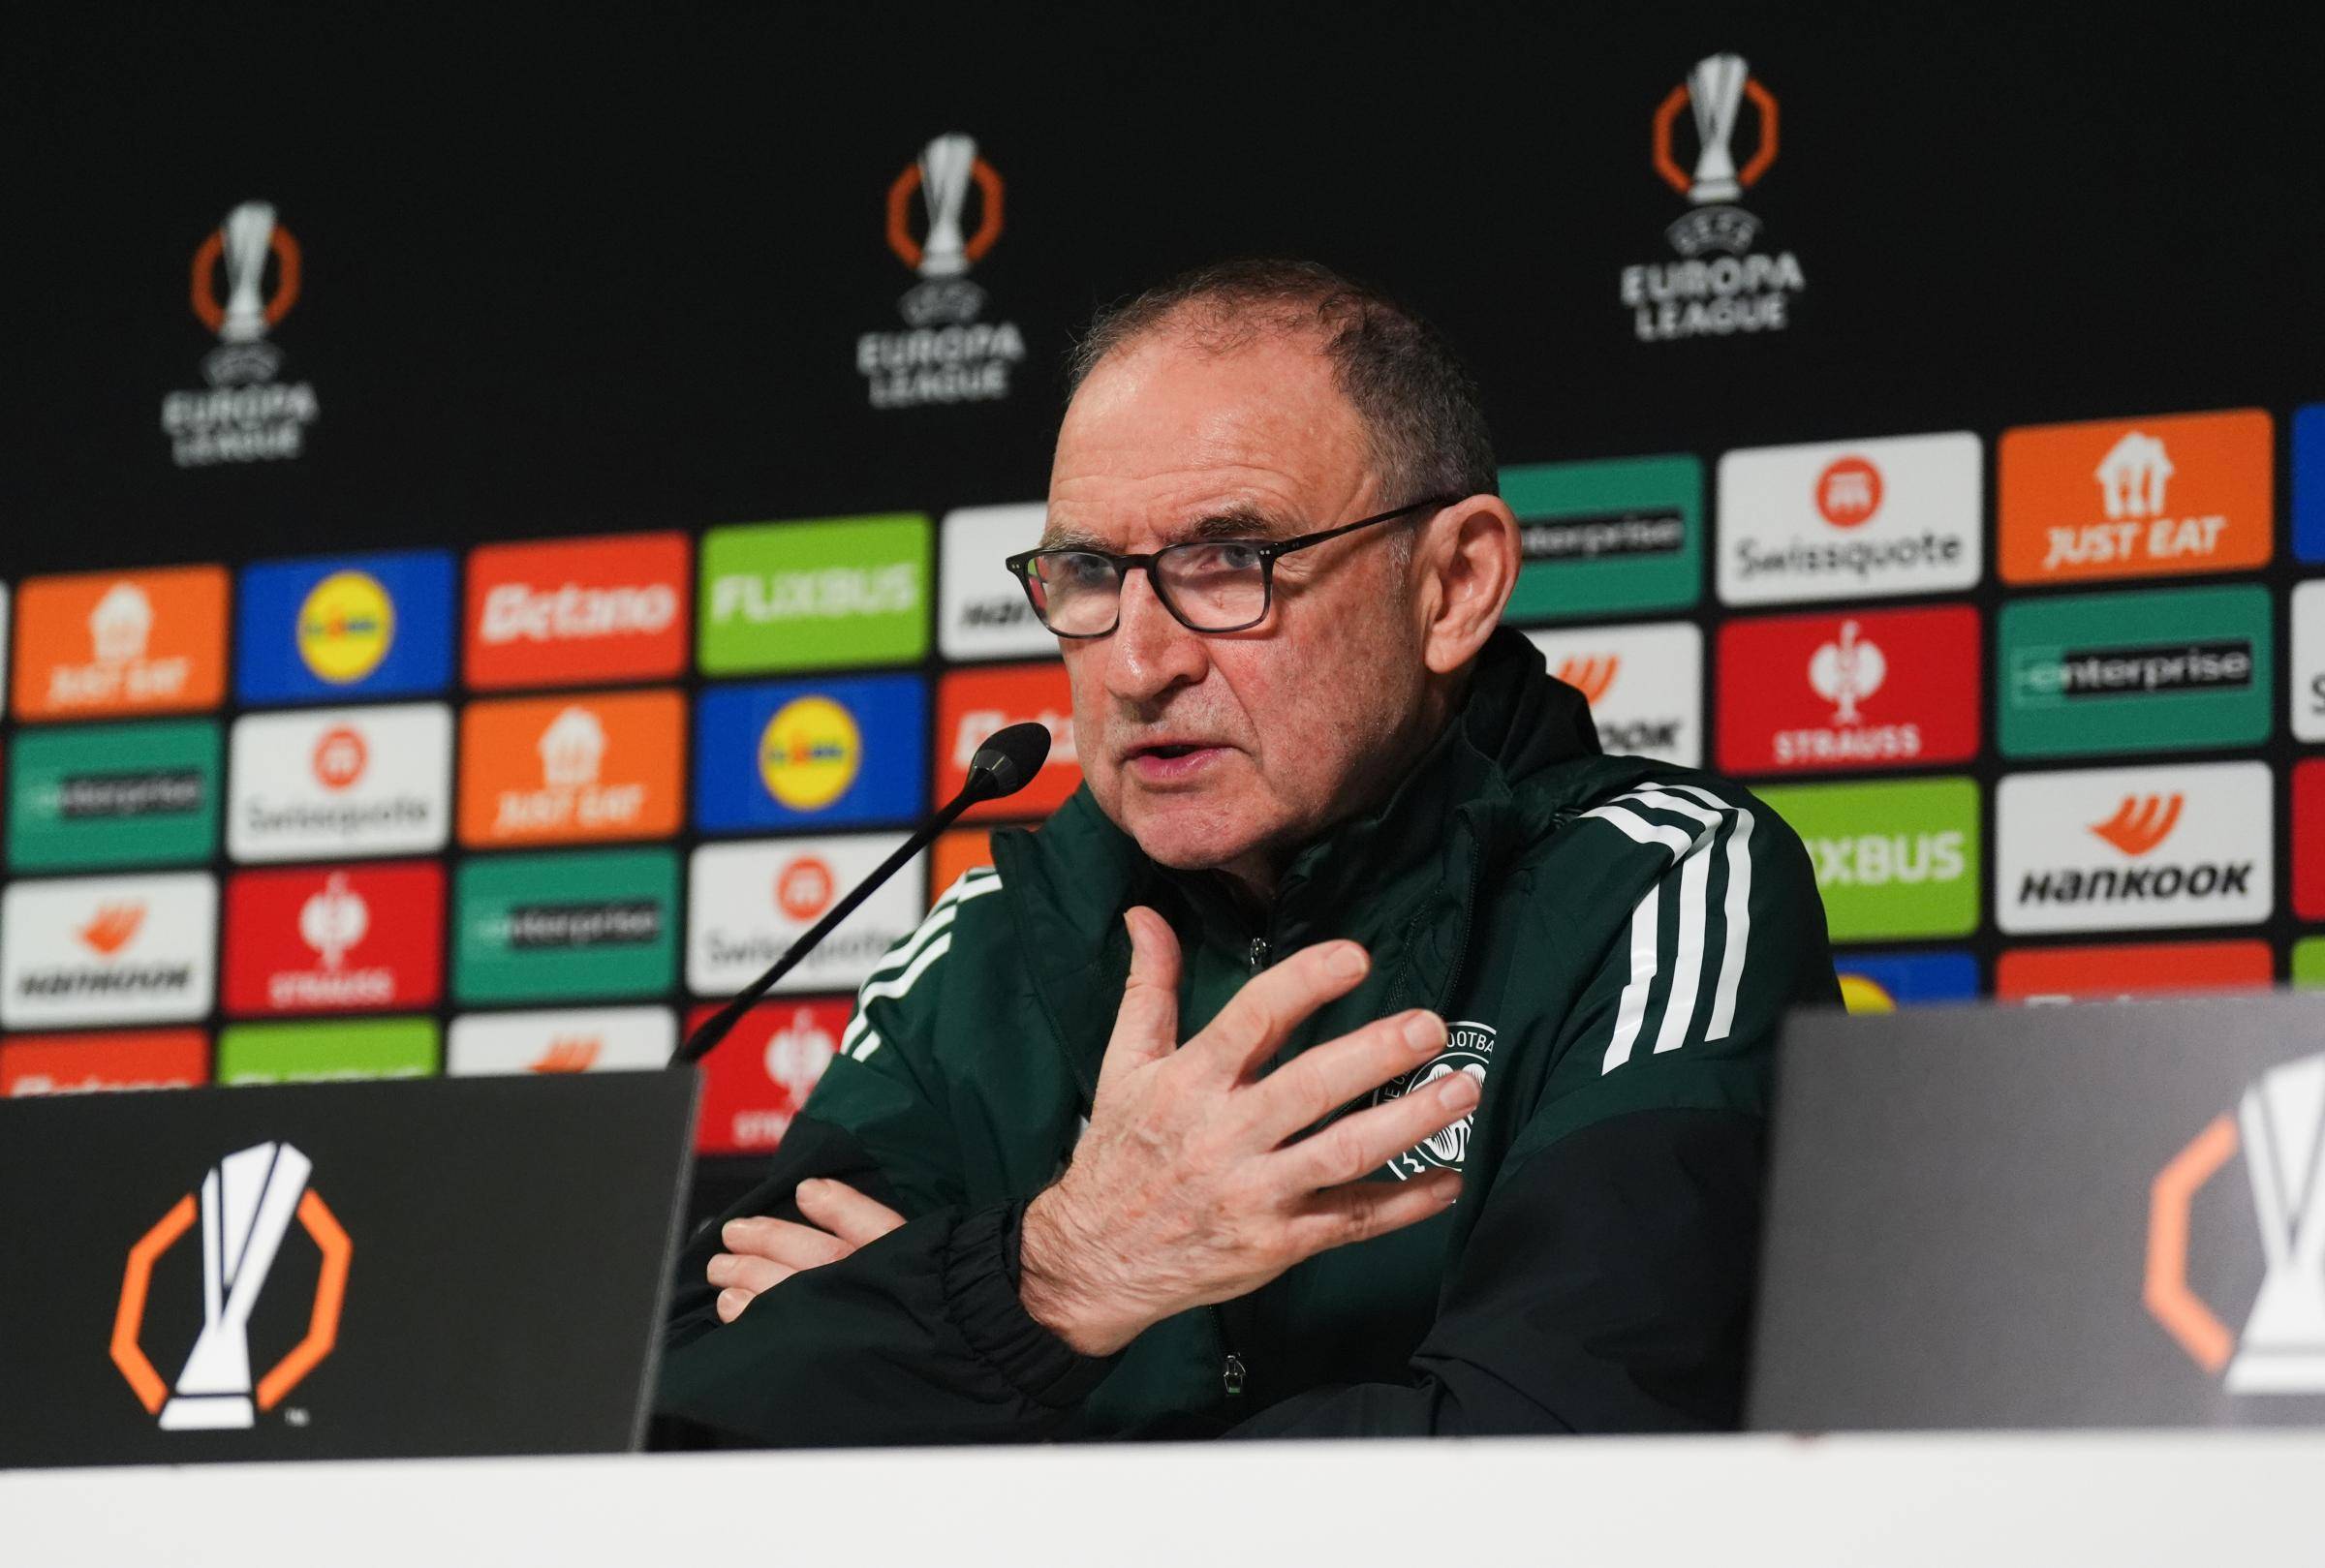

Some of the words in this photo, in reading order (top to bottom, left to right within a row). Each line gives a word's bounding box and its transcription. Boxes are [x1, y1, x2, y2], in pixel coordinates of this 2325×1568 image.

[1621, 254, 1804, 307] EUROPA
[1635, 295, 1788, 340] LEAGUE
[857, 324, 1025, 375] EUROPA
[1736, 532, 1962, 581] Swissquote
[2043, 522, 2136, 569] JUST
[2147, 515, 2225, 558] EAT
[482, 583, 674, 643] Betano
[712, 565, 918, 621] FLIXBUS
[2030, 652, 2251, 692] enterprise
[1774, 723, 1921, 763] STRAUSS
[1446, 1030, 1495, 1054] OOTBA
